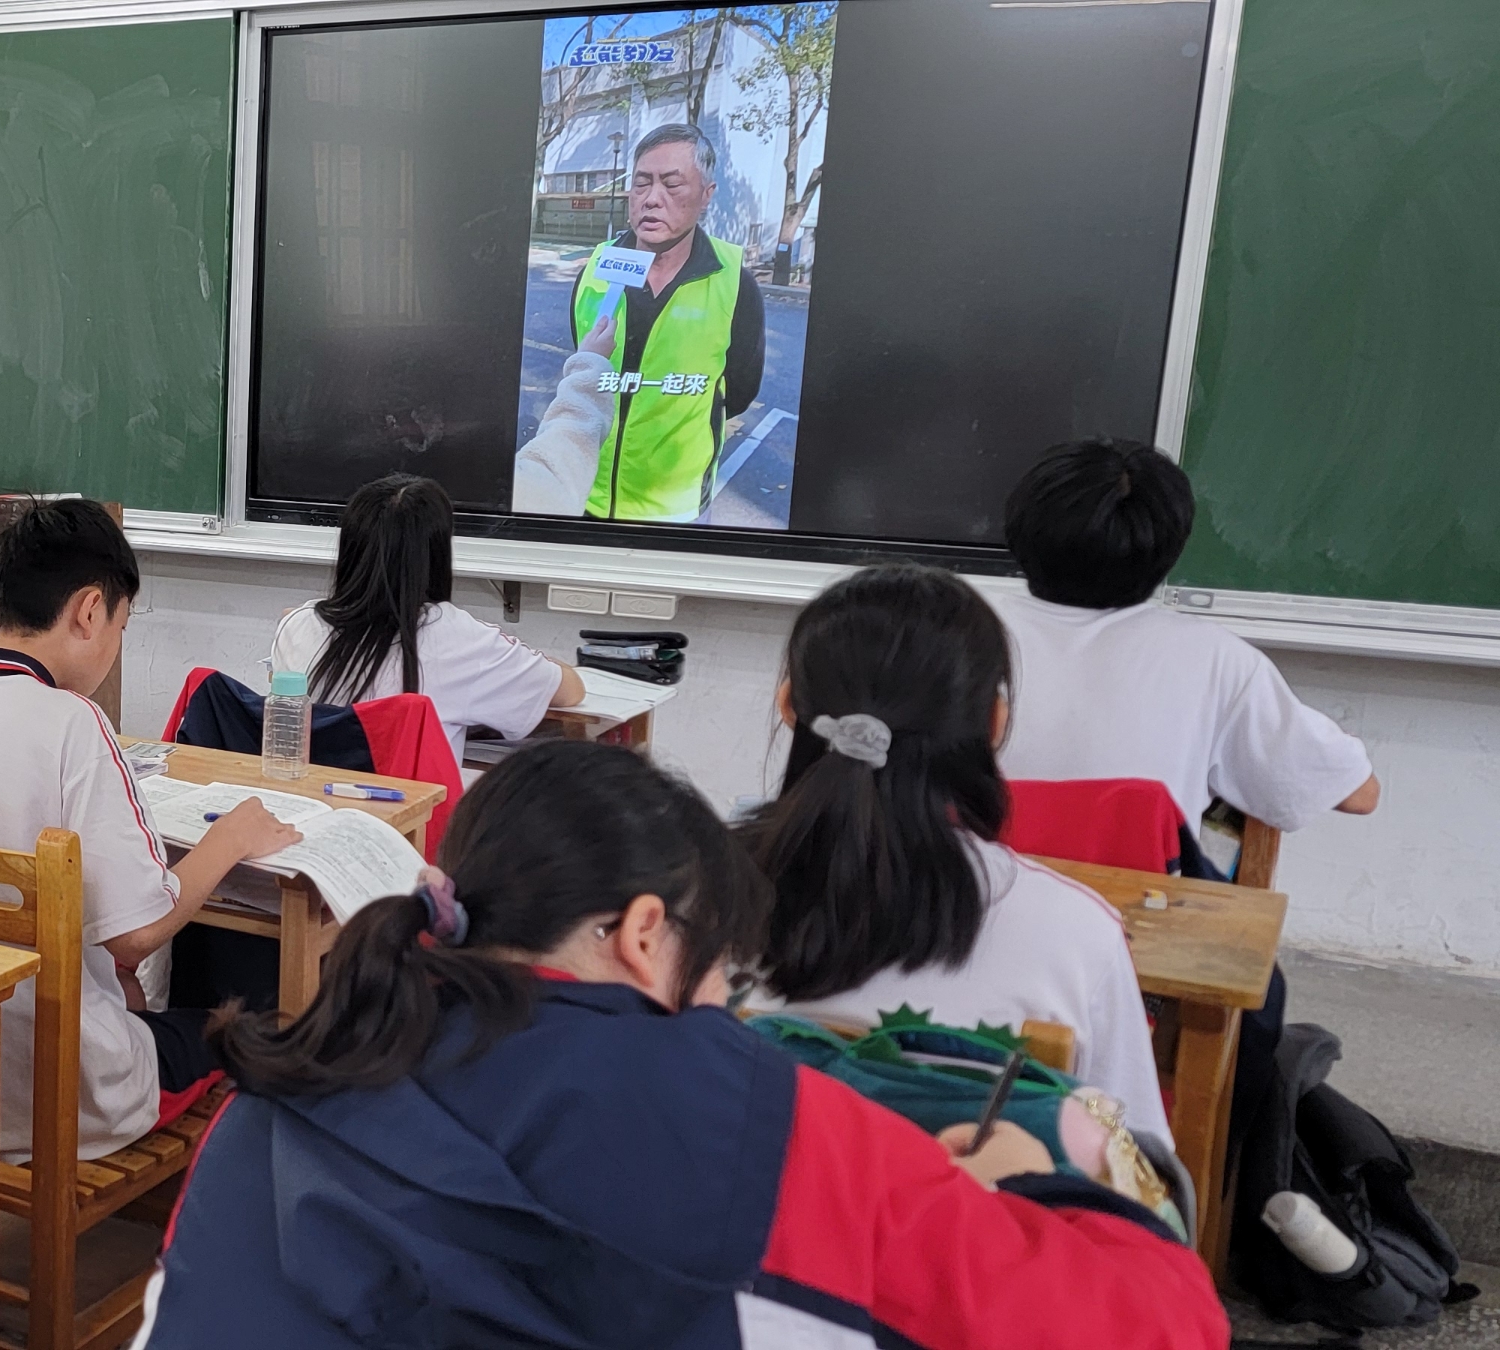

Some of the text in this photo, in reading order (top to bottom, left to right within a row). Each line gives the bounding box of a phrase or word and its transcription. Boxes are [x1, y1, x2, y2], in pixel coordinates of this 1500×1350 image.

[597, 371, 710, 396] 我們一起來
